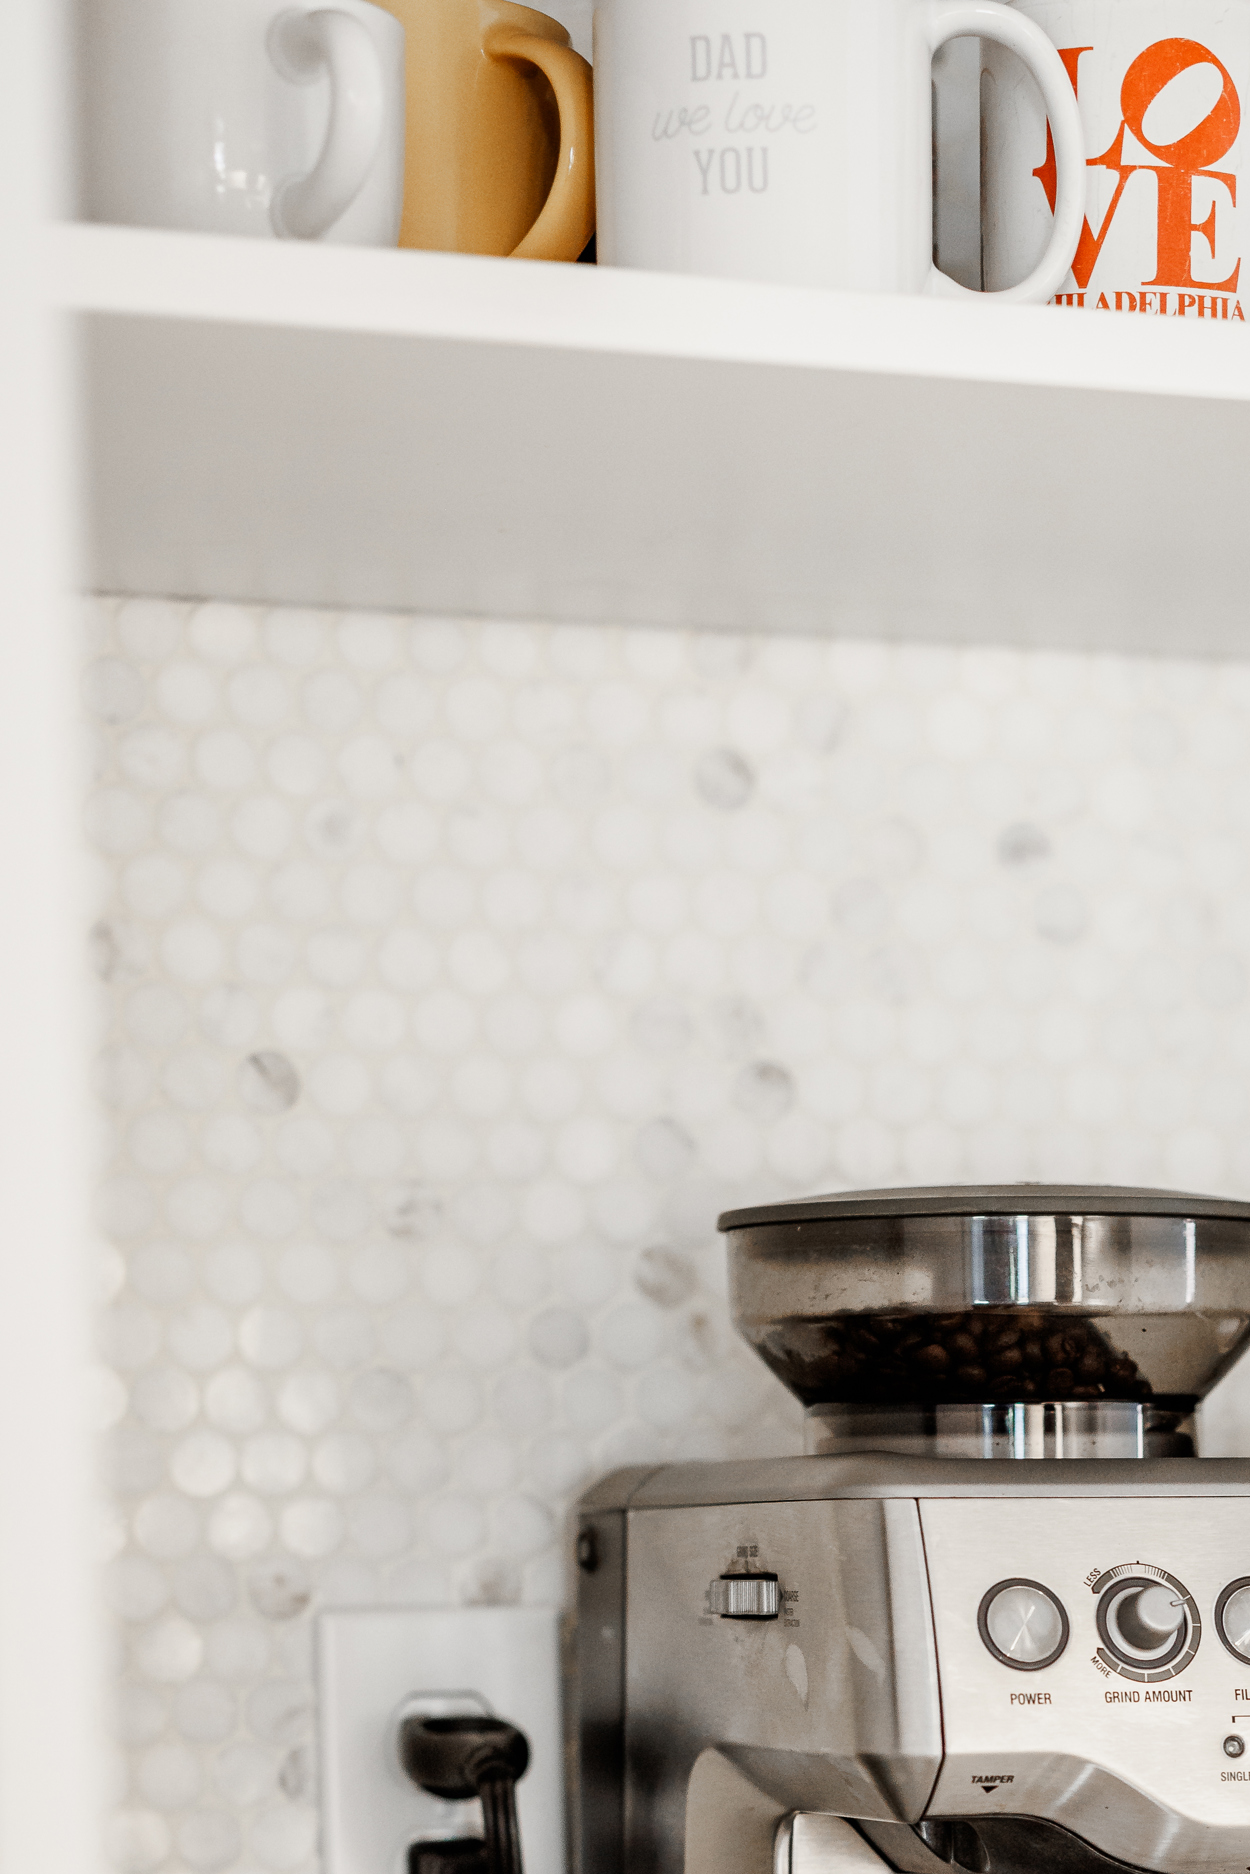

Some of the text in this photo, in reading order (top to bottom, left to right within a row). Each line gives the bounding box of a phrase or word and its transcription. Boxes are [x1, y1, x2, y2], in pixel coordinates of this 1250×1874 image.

[690, 31, 768, 82] DAD
[651, 90, 819, 142] we love
[692, 146, 769, 195] YOU
[1083, 1567, 1102, 1588] LESS
[1090, 1656, 1112, 1679] MORE
[1010, 1693, 1052, 1705] POWER
[1104, 1689, 1193, 1703] GRIND AMOUNT
[971, 1774, 1015, 1784] TAMPER
